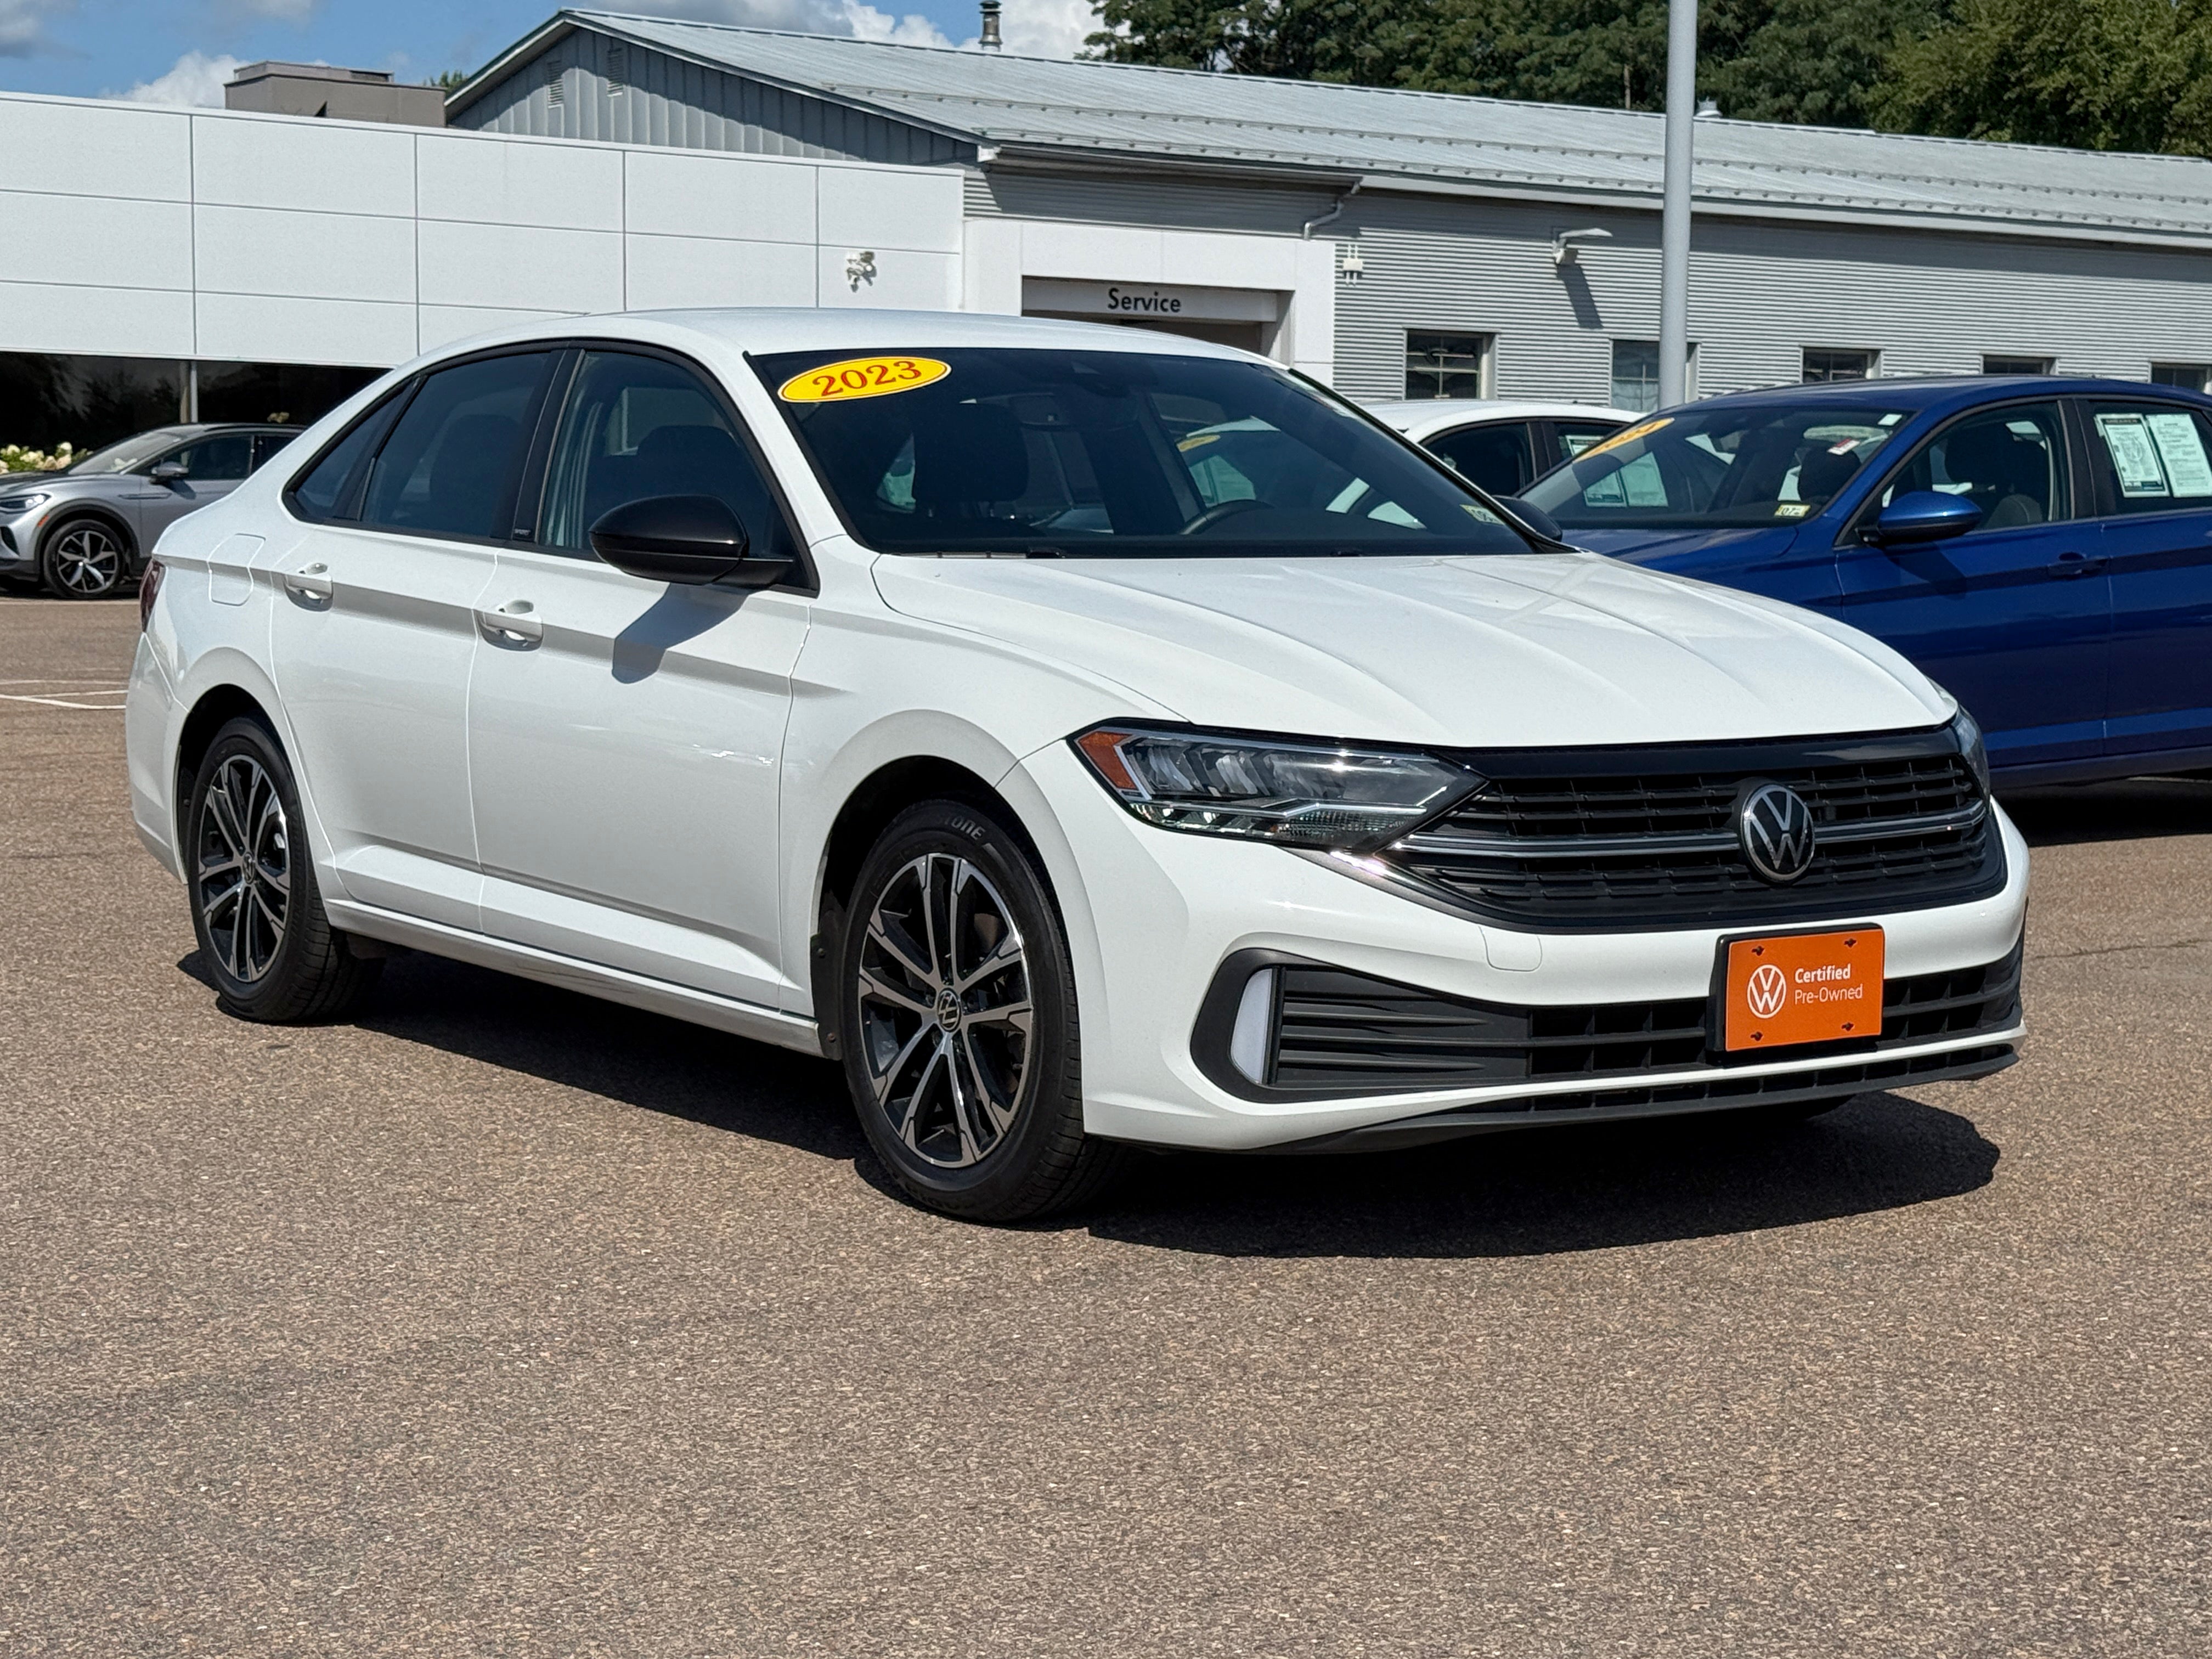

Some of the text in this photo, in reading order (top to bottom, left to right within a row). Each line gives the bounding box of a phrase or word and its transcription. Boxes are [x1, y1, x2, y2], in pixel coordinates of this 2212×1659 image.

[1108, 287, 1181, 312] Service
[812, 360, 922, 397] 2023
[1742, 787, 1812, 875] VW
[1795, 963, 1851, 984] Certified
[1748, 966, 1785, 1015] VW
[1795, 983, 1864, 1005] Pre-Owned
